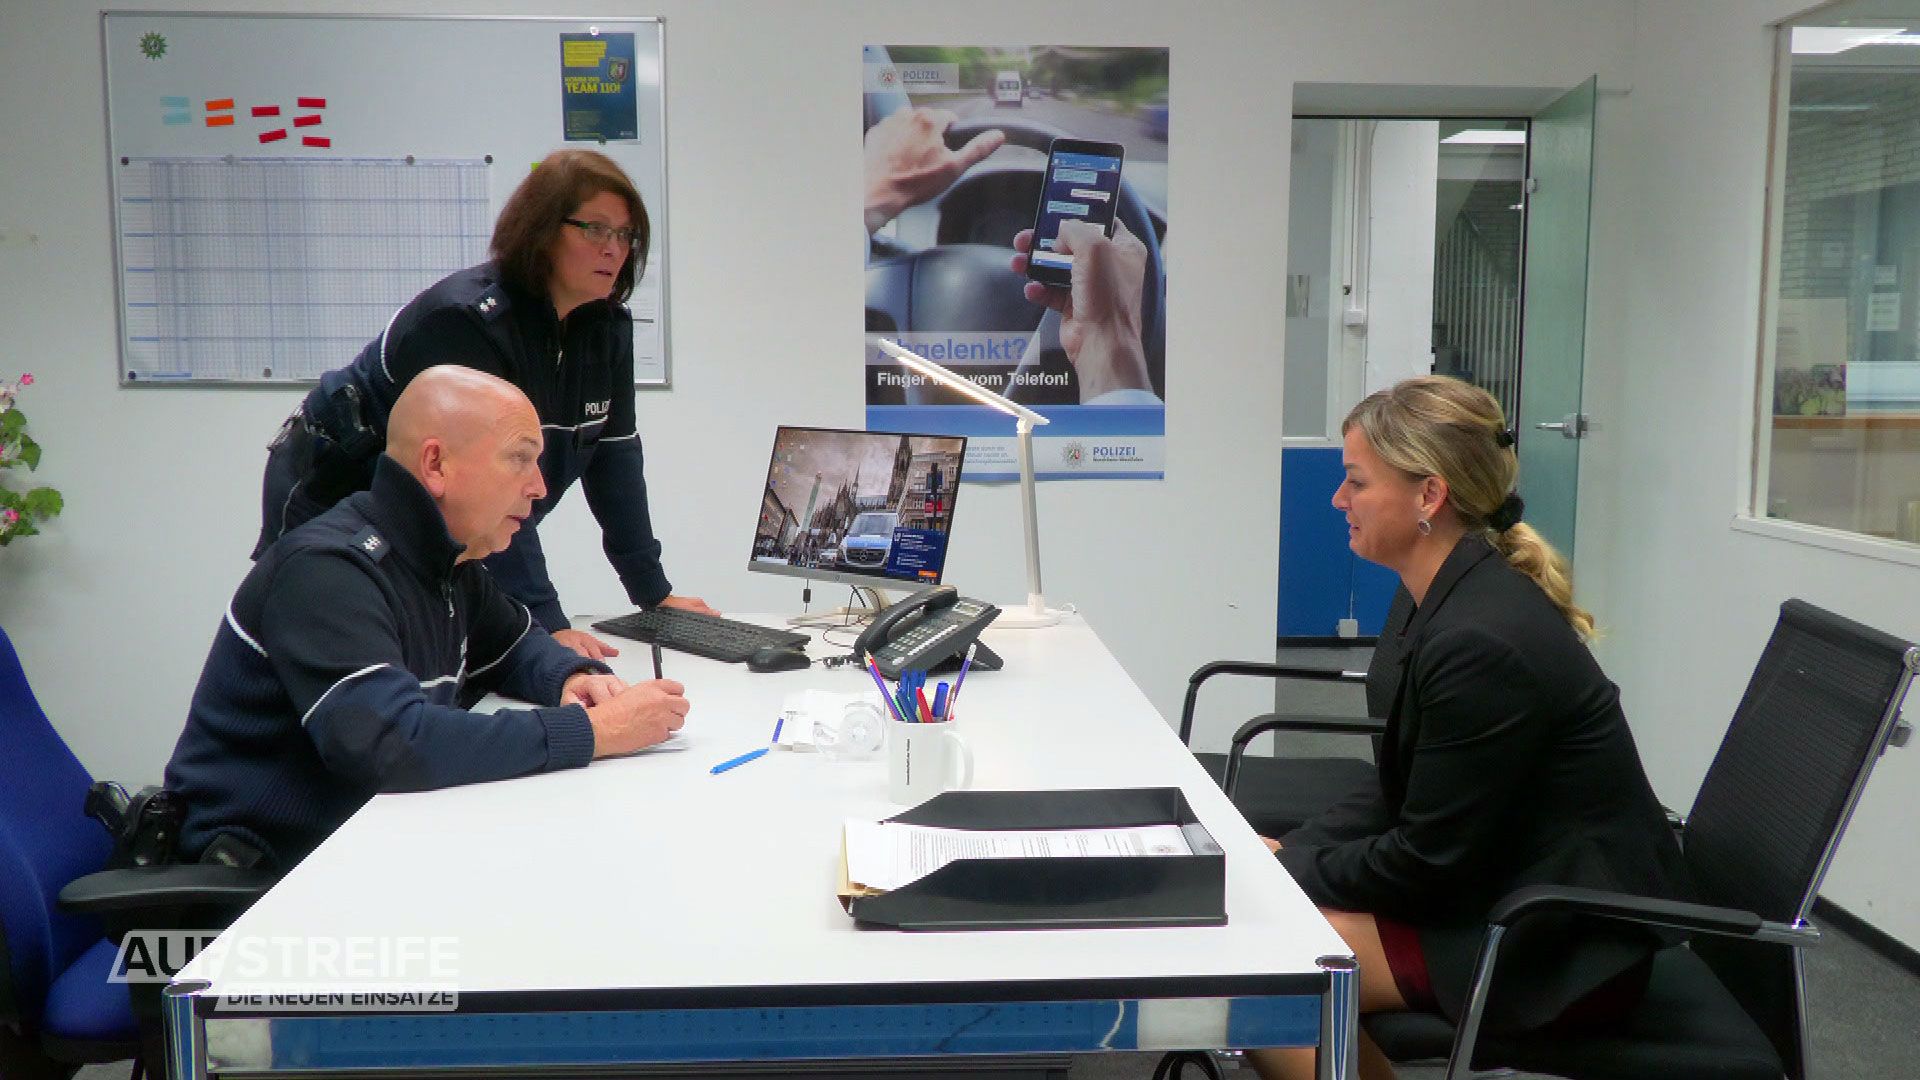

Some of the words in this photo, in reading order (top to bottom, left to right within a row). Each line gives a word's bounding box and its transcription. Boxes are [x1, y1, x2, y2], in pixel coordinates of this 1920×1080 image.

[903, 70, 940, 80] POLIZEI
[567, 83, 598, 94] TEAM
[877, 372, 926, 388] Finger
[968, 374, 1003, 386] vom
[1007, 371, 1069, 386] Telefon!
[1093, 446, 1136, 456] POLIZEI
